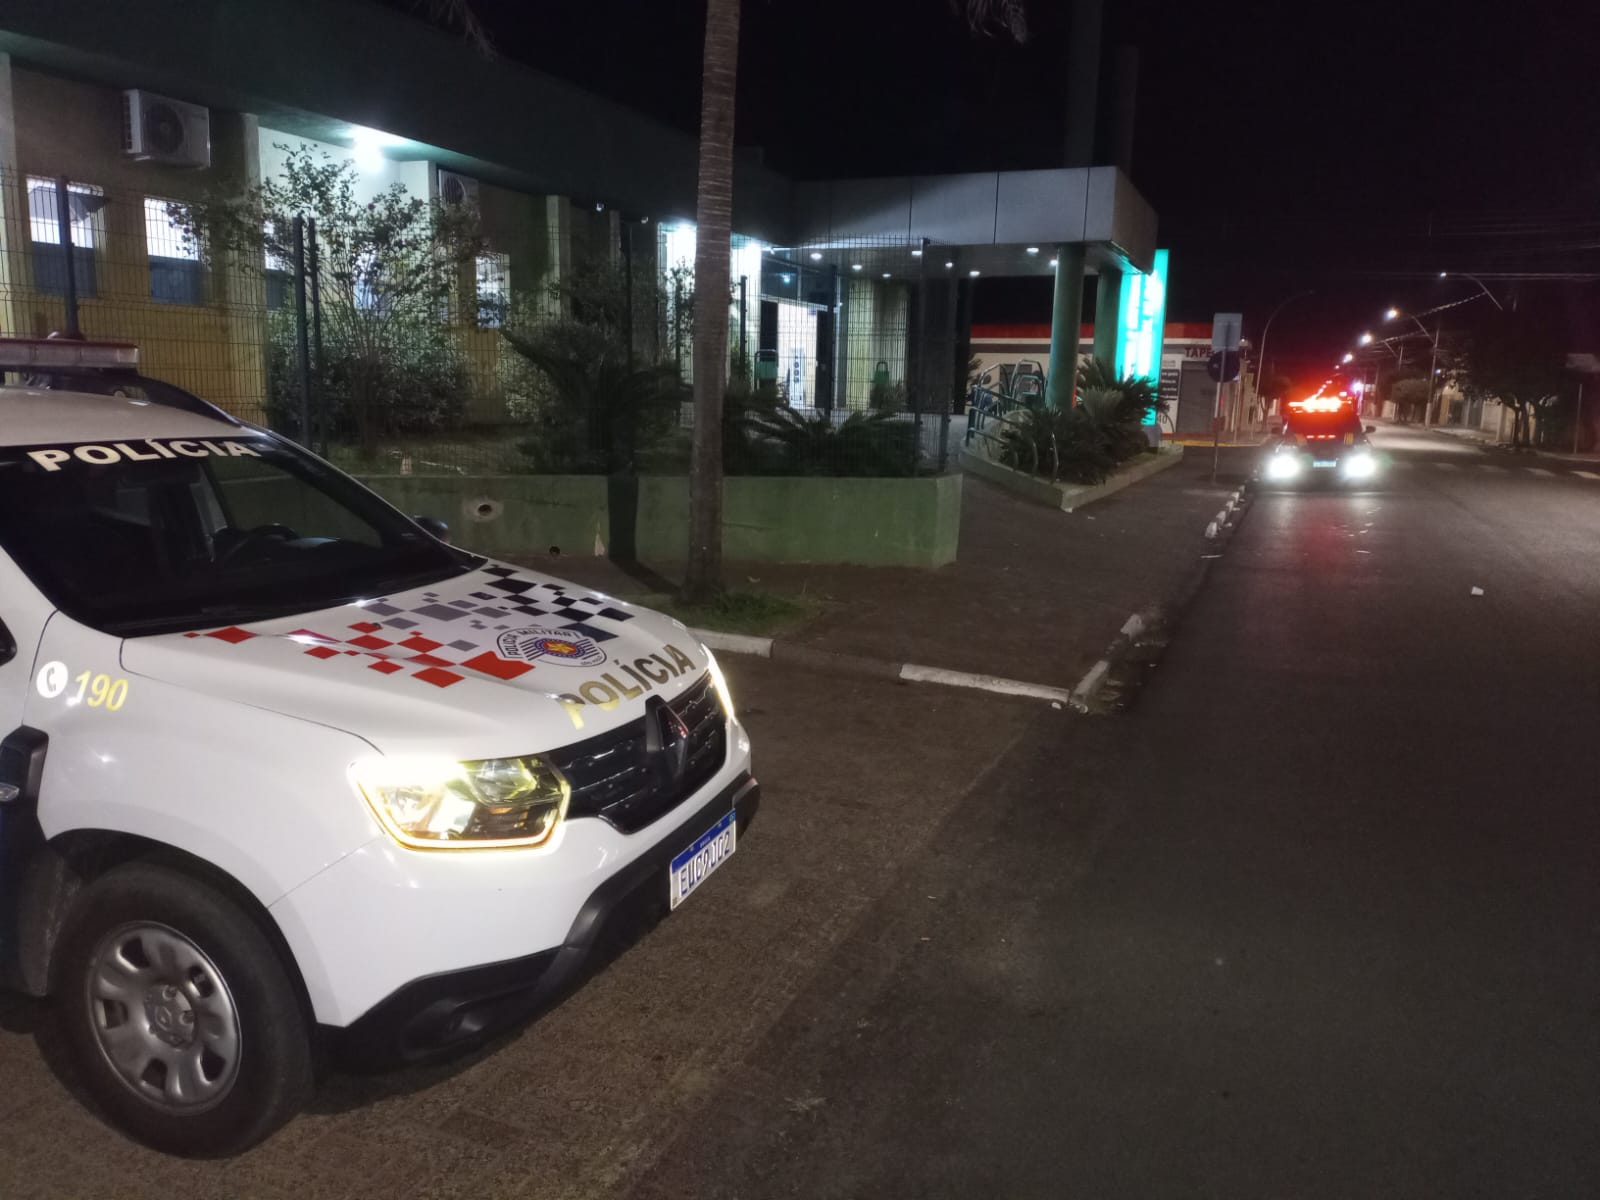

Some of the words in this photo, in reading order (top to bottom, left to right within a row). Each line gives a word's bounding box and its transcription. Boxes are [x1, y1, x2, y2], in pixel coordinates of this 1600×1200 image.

[1184, 346, 1214, 358] TAPE
[27, 438, 262, 472] POLÍCIA
[516, 628, 572, 638] MILITAR
[74, 669, 130, 711] 190
[558, 643, 697, 730] POLÍCIA
